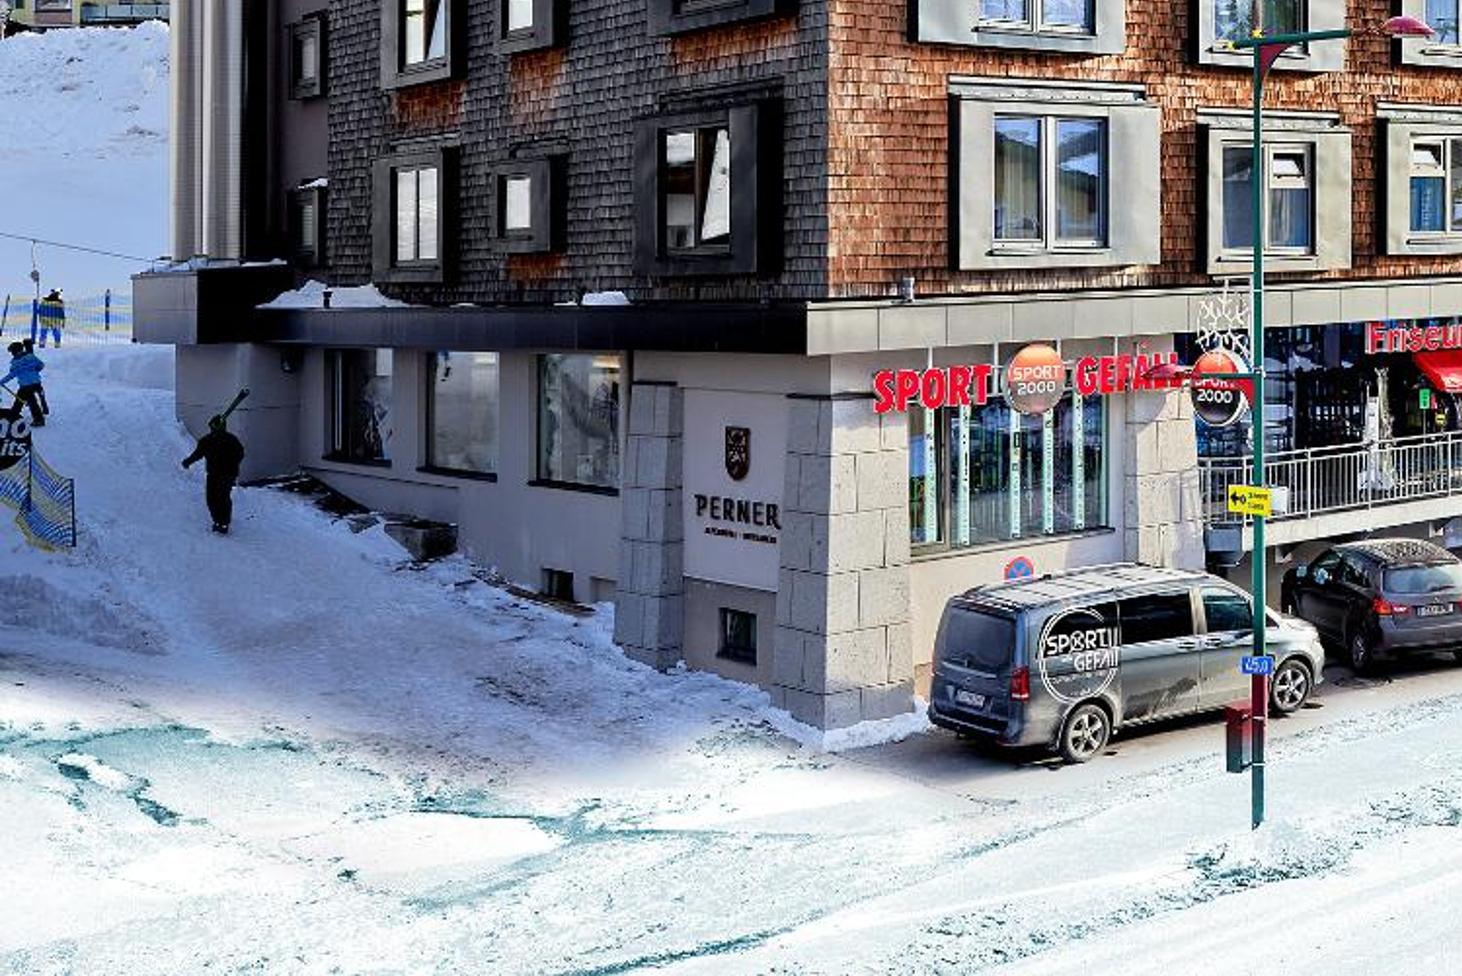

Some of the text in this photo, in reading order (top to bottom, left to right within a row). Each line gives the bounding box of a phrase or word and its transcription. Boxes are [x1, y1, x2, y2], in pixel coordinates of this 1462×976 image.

[1013, 365, 1061, 381] SPORT
[874, 364, 992, 414] SPORT
[1017, 381, 1057, 396] 2000
[1196, 388, 1233, 404] 2000
[693, 493, 782, 530] PERNER
